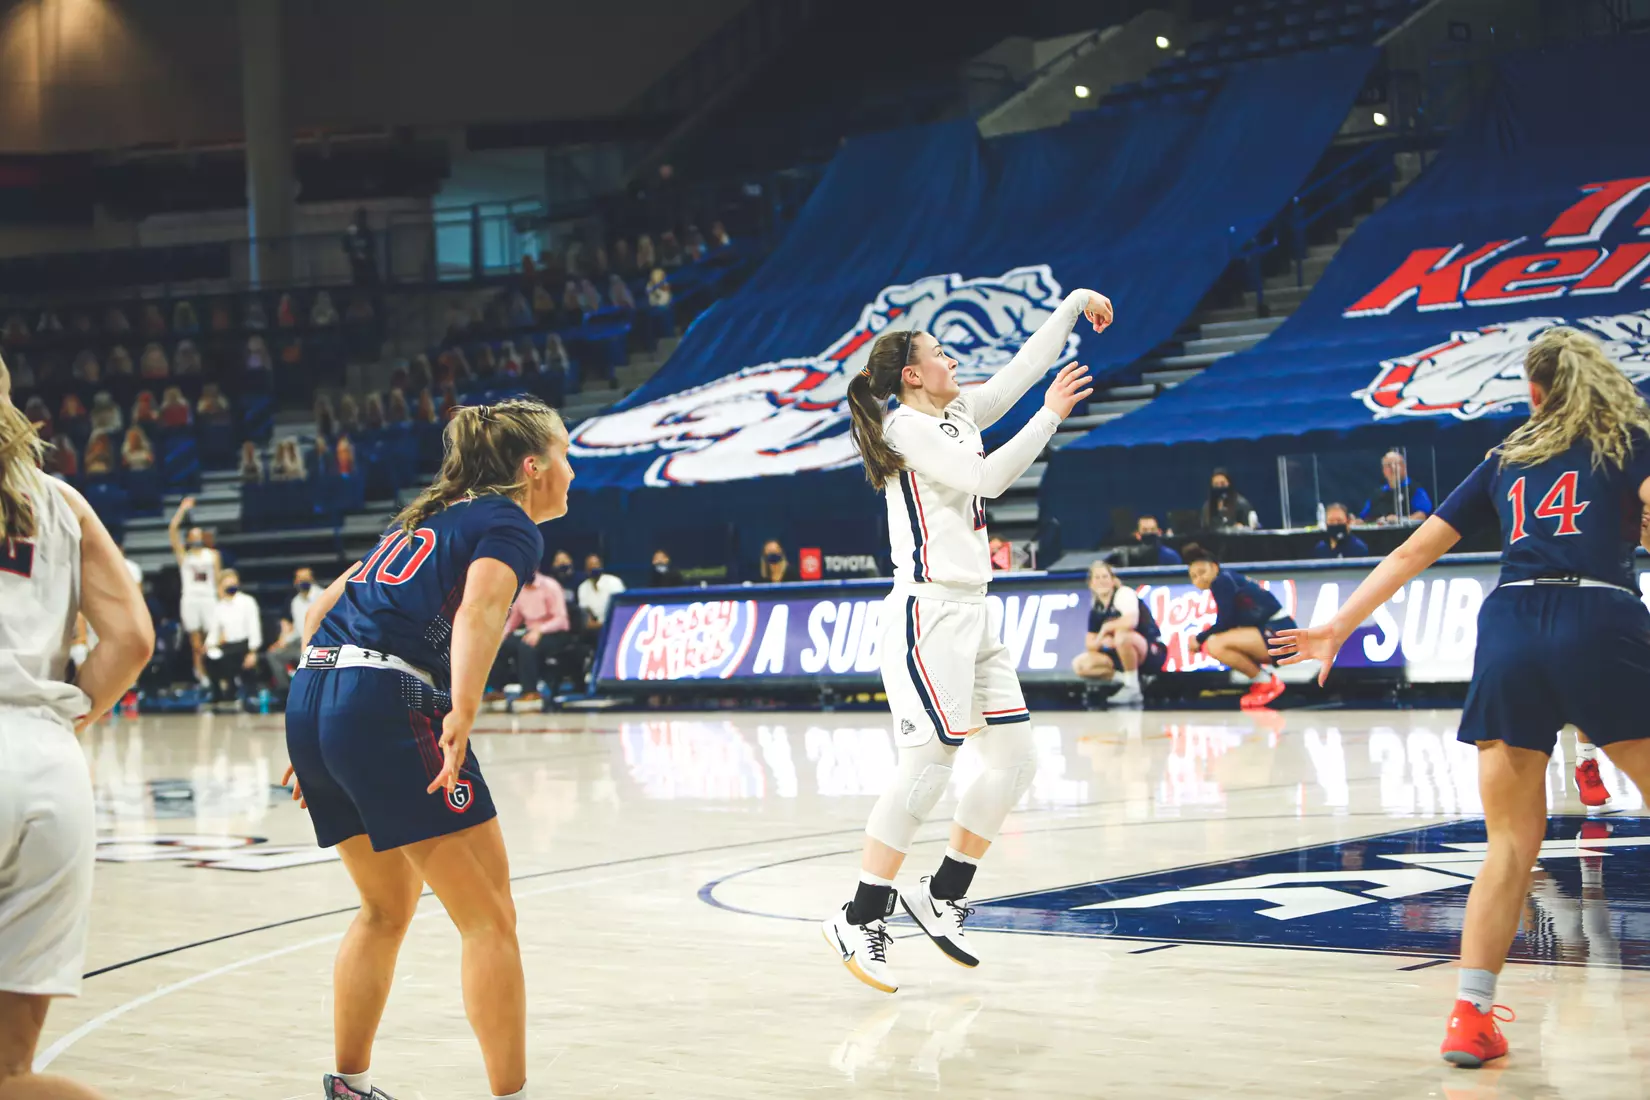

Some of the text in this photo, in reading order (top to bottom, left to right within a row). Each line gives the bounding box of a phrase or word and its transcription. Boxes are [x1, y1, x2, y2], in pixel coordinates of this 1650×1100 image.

[1507, 471, 1591, 545] 14
[347, 528, 436, 585] 10
[824, 555, 877, 571] TOYOTA
[752, 604, 789, 674] A
[800, 600, 885, 673] SUB
[1362, 578, 1484, 662] SUB
[453, 787, 465, 806] G
